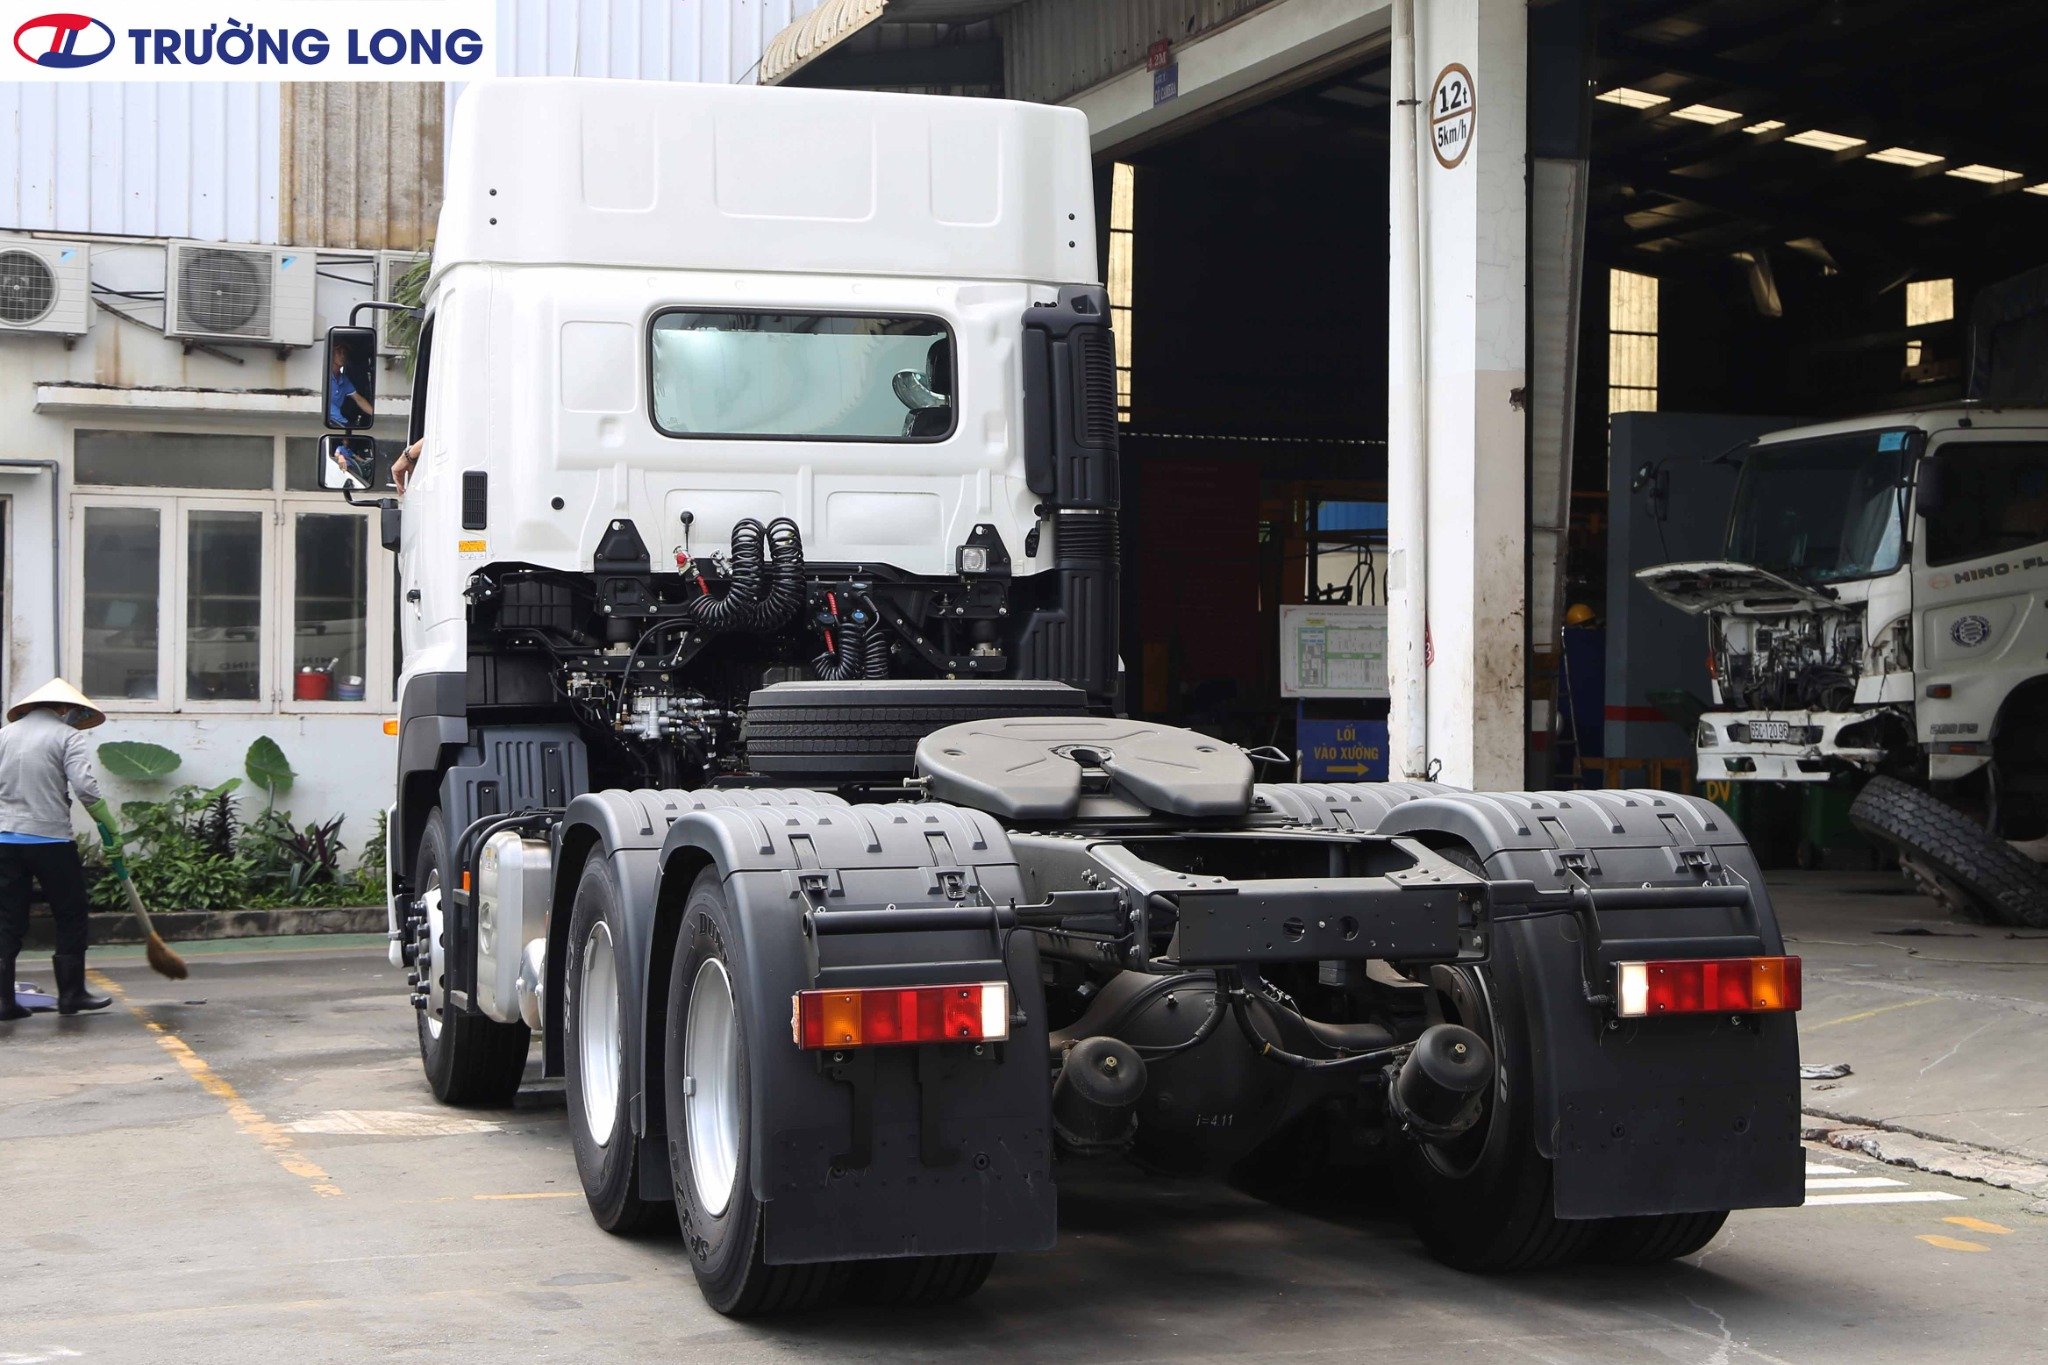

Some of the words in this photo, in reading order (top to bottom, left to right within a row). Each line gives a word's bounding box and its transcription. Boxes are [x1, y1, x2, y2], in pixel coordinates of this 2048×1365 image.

[1437, 119, 1467, 147] 5km/h
[1954, 562, 2010, 584] HINO
[1336, 723, 1356, 741] LỐI
[1314, 742, 1337, 760] VÀO
[1340, 741, 1379, 760] XƯỞNG
